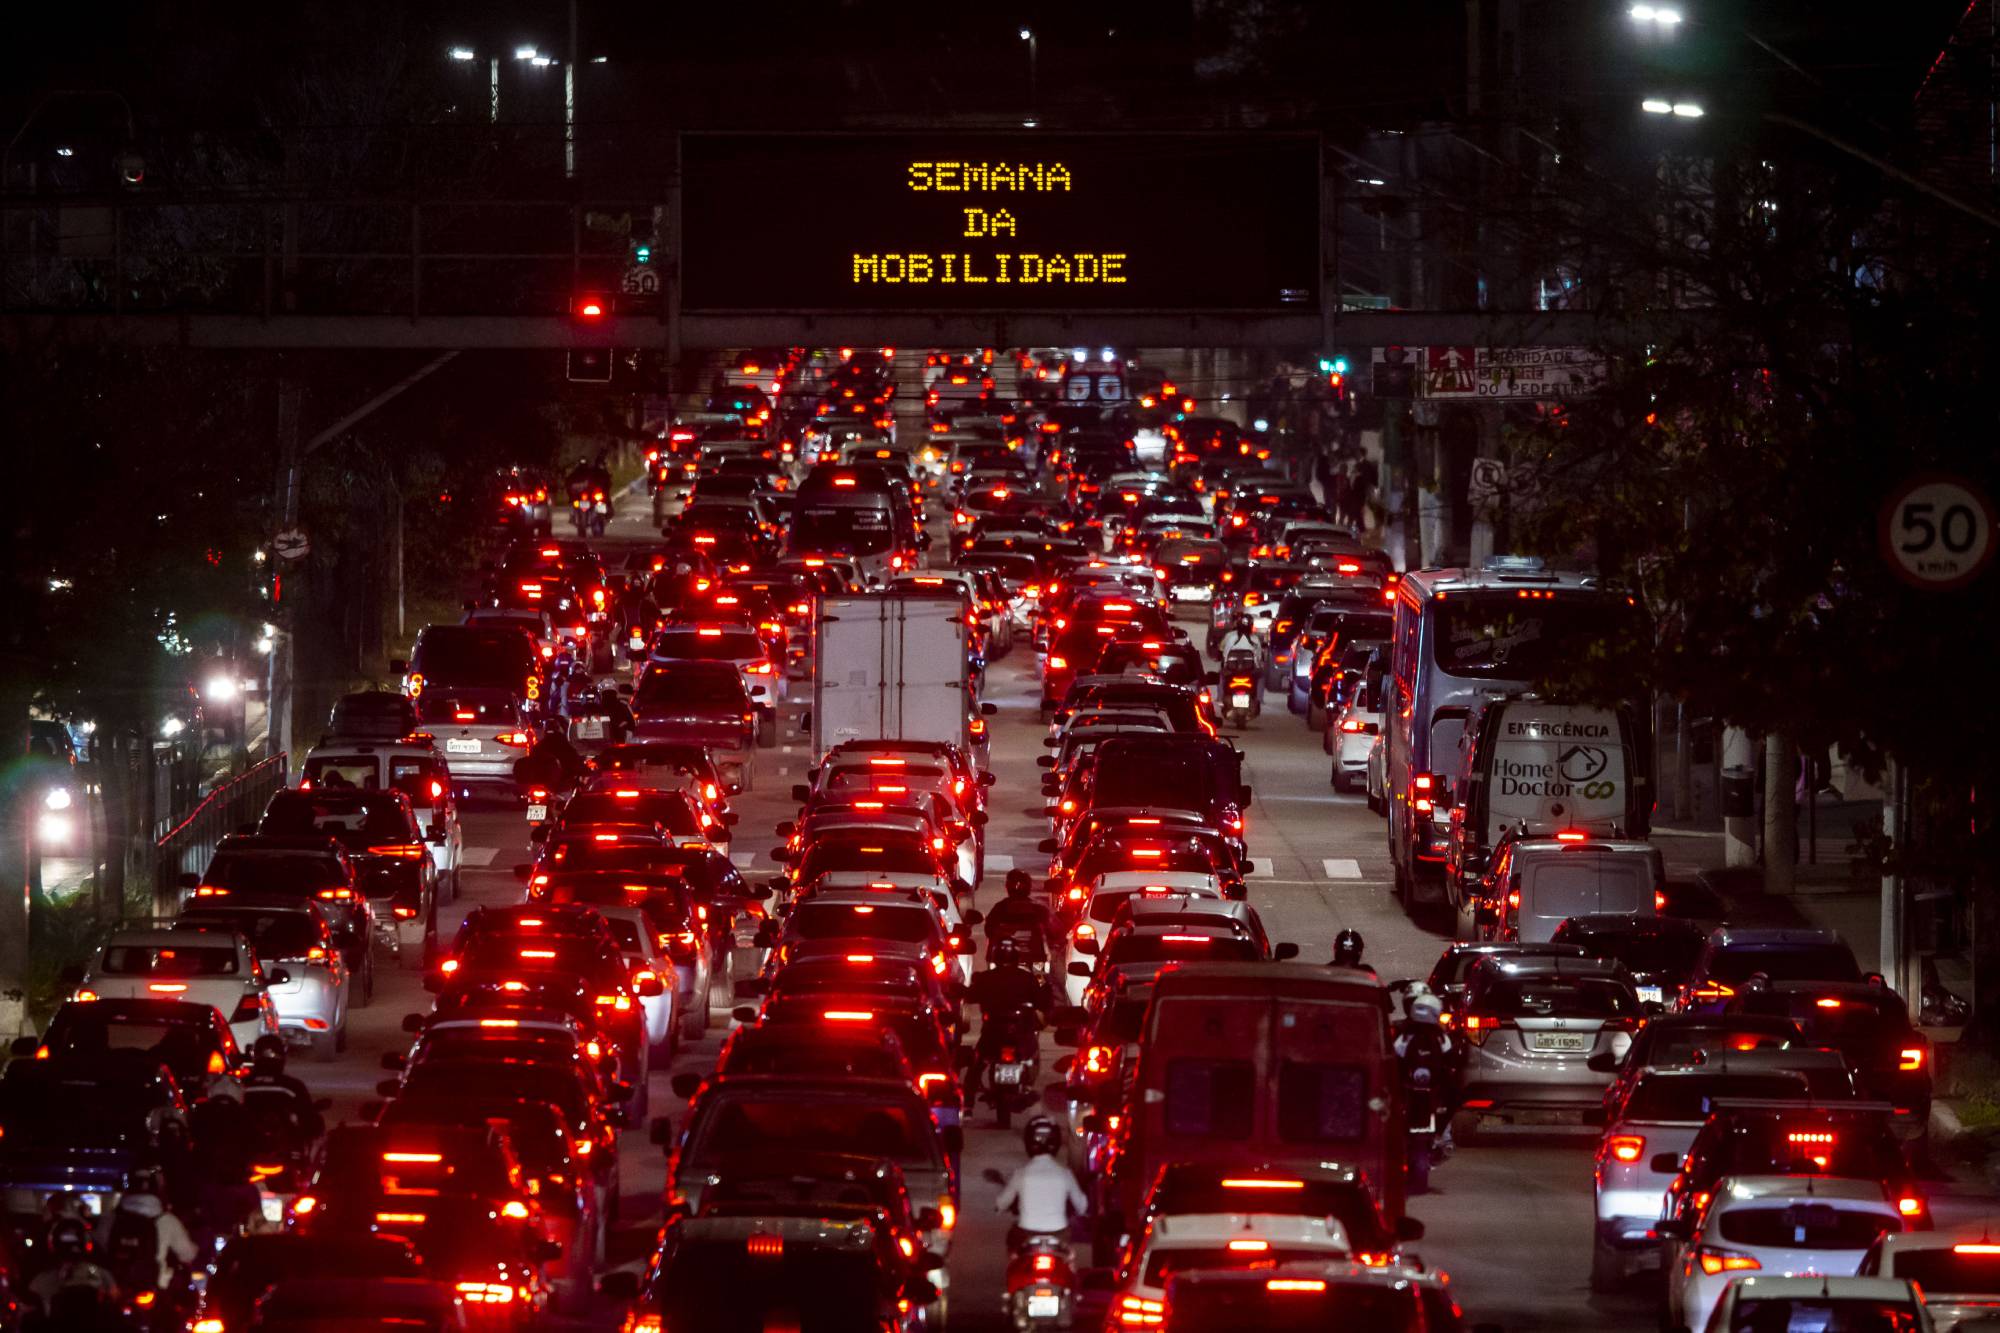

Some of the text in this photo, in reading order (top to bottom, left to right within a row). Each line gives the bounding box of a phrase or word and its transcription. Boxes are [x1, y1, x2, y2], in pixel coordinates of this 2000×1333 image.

[908, 162, 1070, 191] SEMANA
[964, 208, 1016, 237] DA
[853, 254, 1127, 283] MOBILIDADE
[627, 274, 655, 292] 50
[1479, 383, 1498, 395] DO
[1901, 503, 1977, 554] 50
[1917, 560, 1958, 573] km/h
[1507, 721, 1609, 738] EMERGÊNCIA
[1494, 758, 1553, 778] Home
[1501, 777, 1575, 797] Doctor
